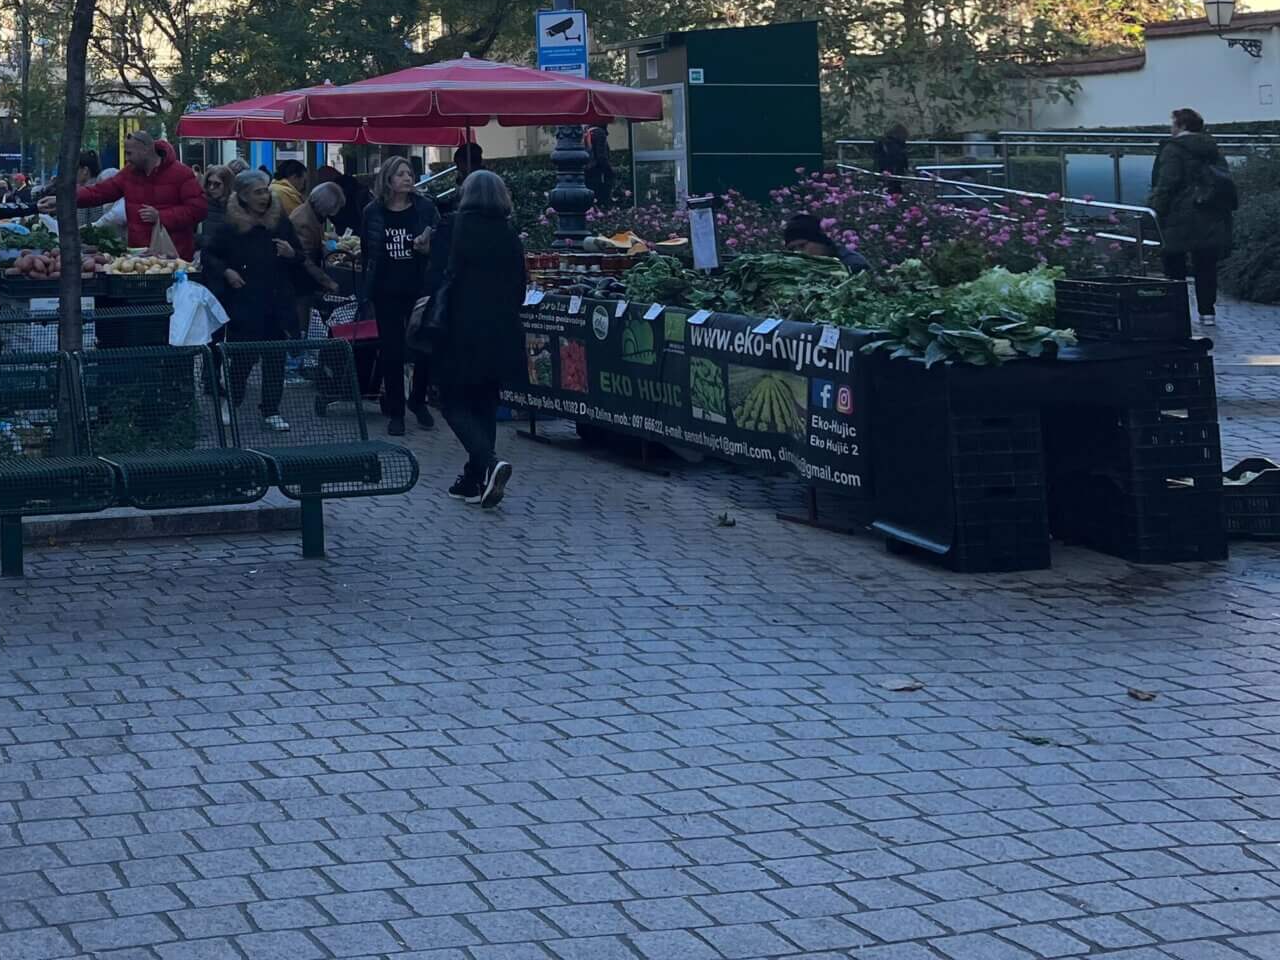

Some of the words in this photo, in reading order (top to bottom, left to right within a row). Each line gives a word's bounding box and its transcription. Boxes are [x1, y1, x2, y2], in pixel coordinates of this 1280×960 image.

[392, 233, 414, 243] are
[600, 371, 632, 396] EKO
[632, 414, 643, 428] 097
[810, 435, 824, 449] Eko
[852, 444, 859, 456] 2
